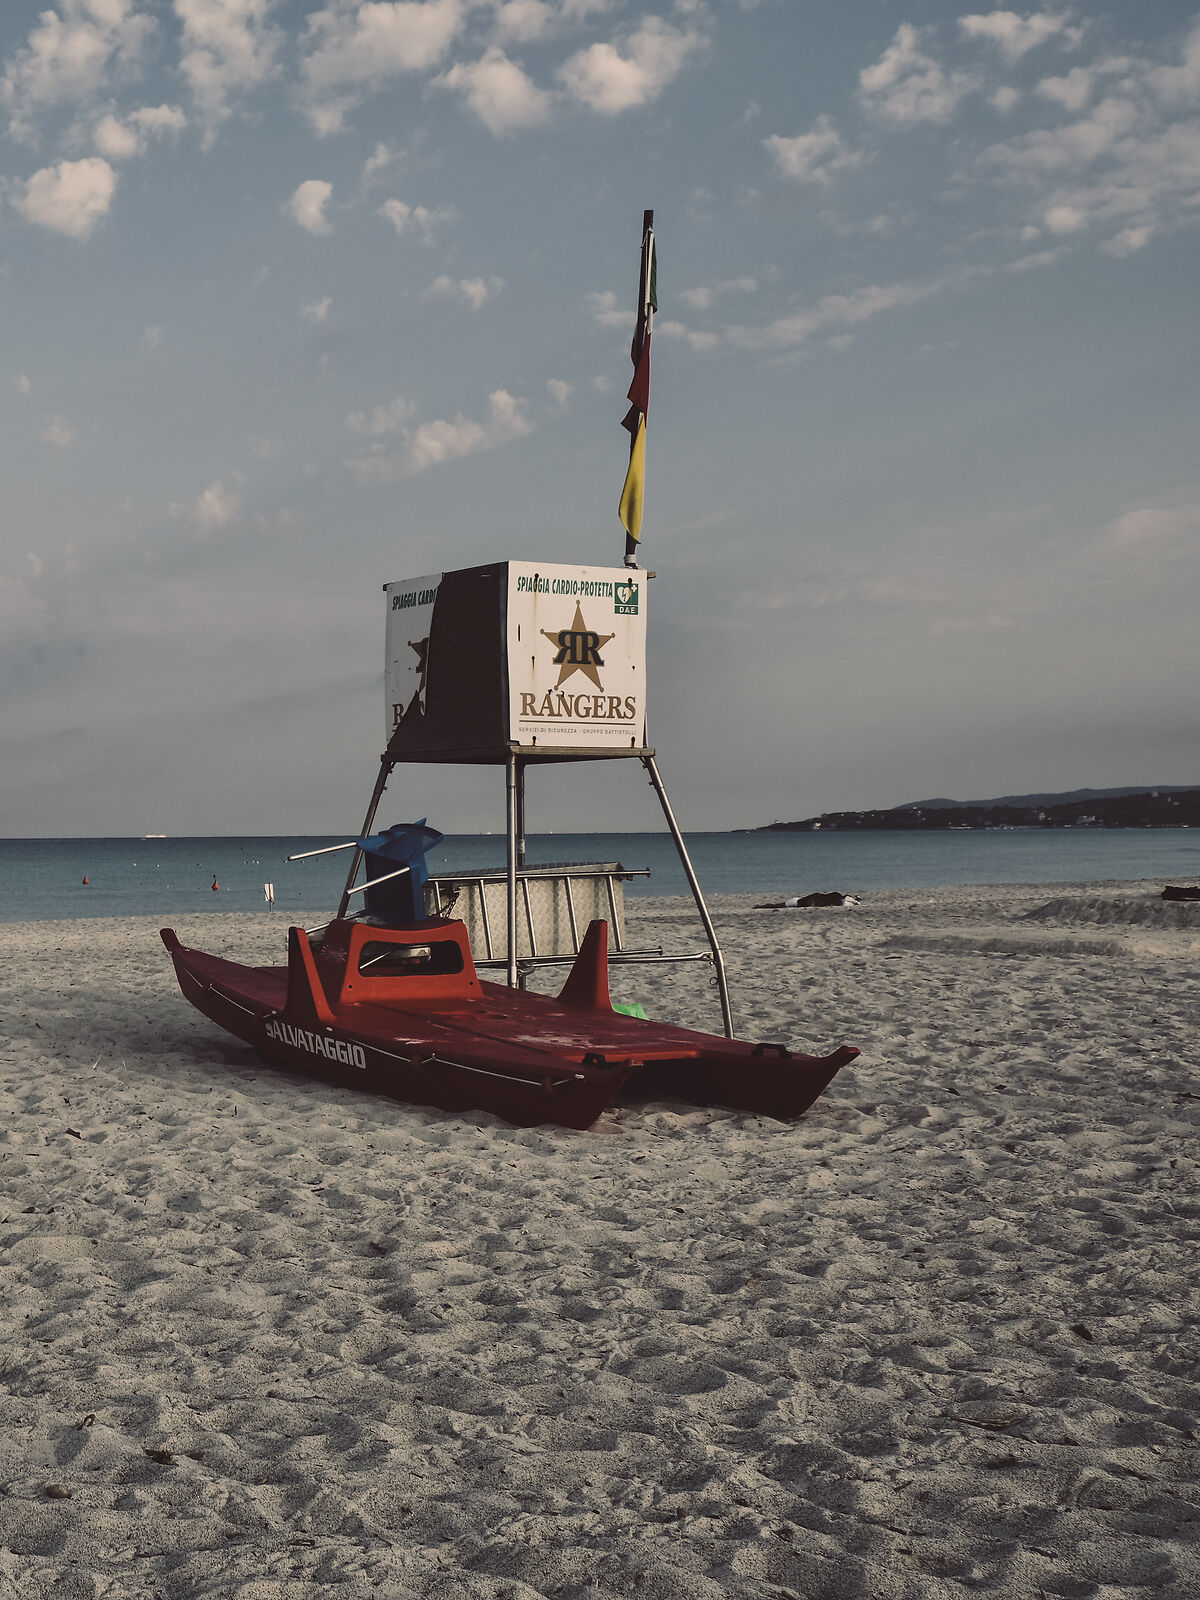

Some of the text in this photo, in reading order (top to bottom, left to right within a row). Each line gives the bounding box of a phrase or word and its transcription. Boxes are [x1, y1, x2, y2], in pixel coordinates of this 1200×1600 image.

[517, 576, 613, 597] SPIAGGIA CARDIO-PROTETTA
[619, 606, 636, 614] DAE
[519, 692, 636, 719] RANGERS
[265, 1020, 367, 1069] SALVATAGGIO
